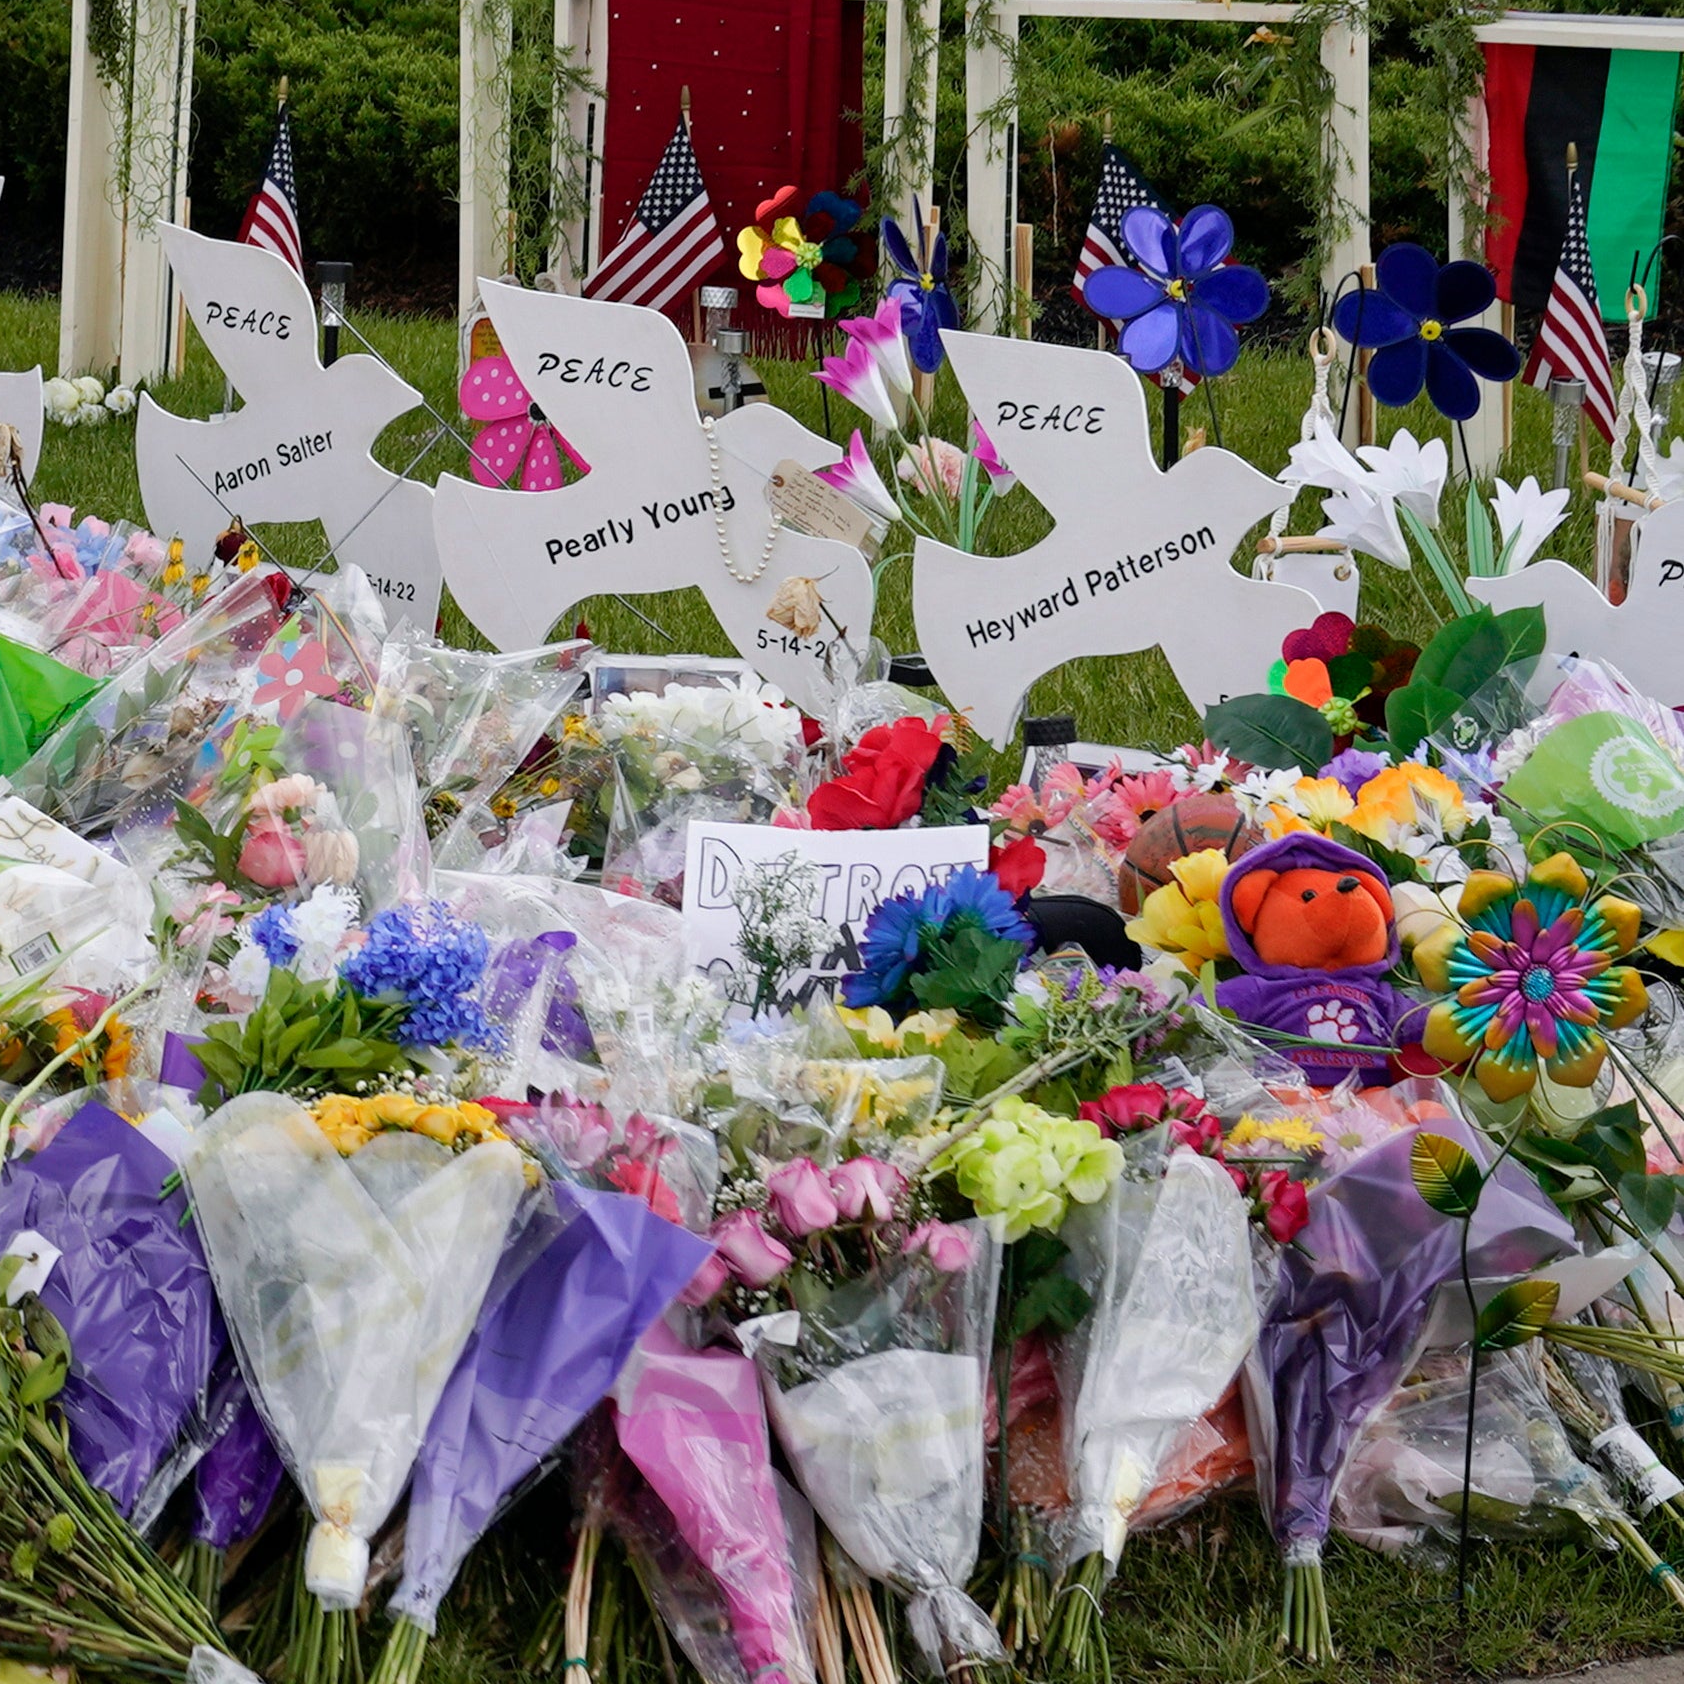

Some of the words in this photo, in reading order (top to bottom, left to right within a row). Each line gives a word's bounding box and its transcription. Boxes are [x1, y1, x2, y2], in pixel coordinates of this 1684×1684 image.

[206, 301, 291, 340] PEACE
[538, 353, 653, 392] PEACE
[998, 401, 1105, 434] PEACE
[214, 457, 271, 494] Aaron
[277, 430, 333, 466] Salter
[545, 518, 633, 564] Pearly
[642, 485, 735, 529] Young
[966, 577, 1079, 648] Heyward
[1085, 526, 1216, 596] Patterson
[698, 837, 984, 922] DTRO
